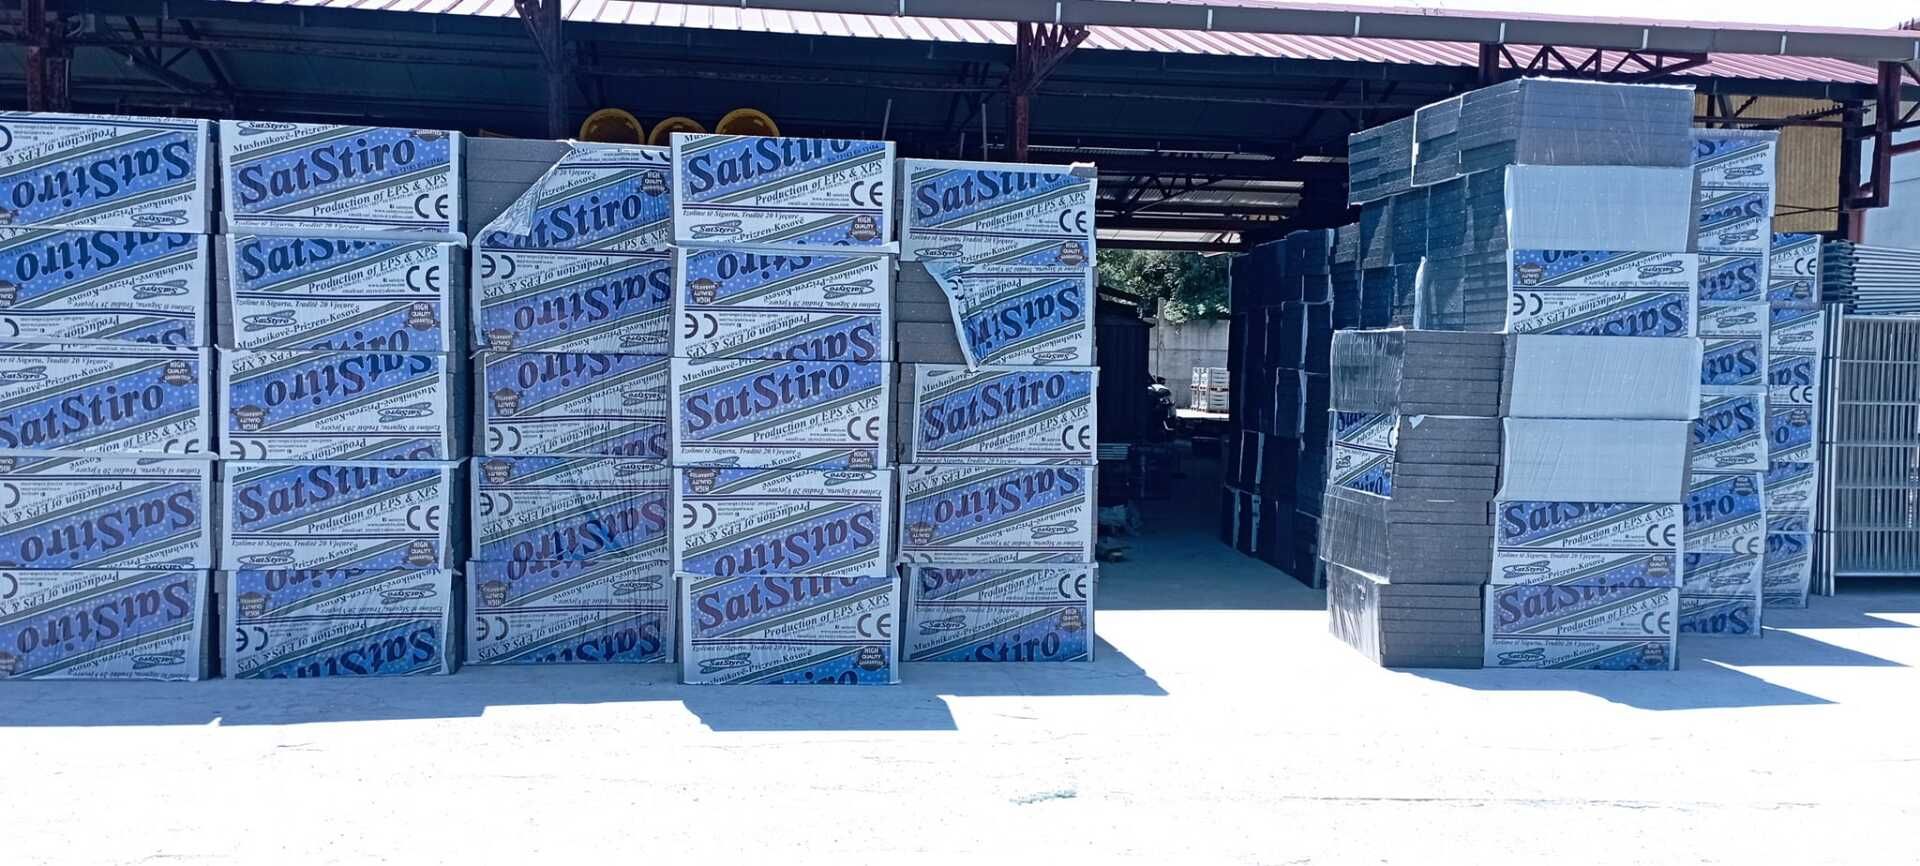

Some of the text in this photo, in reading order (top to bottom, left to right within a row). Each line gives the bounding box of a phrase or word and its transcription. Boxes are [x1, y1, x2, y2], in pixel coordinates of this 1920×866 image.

[44, 144, 54, 153] of
[58, 127, 117, 149] Production
[19, 150, 40, 159] EPS
[13, 140, 190, 208] SatStiro
[239, 139, 415, 206] SatStiro
[755, 184, 808, 205] Production
[812, 179, 821, 190] of
[825, 174, 846, 186] EPS
[861, 161, 882, 174] XPS
[313, 194, 369, 216] Production
[373, 189, 384, 200] of
[387, 183, 409, 198] EPS
[425, 174, 447, 188] XPS
[975, 212, 1024, 230] Production
[1026, 206, 1036, 218] of
[1037, 201, 1056, 213] EPS
[1069, 192, 1086, 205] XPS
[308, 272, 364, 293] Production
[367, 265, 377, 277] of
[380, 260, 402, 274] EPS
[416, 246, 438, 260] XPS
[543, 272, 554, 282] of
[558, 257, 609, 278] Production
[520, 275, 542, 288] EPS
[484, 287, 504, 298] XPS
[514, 268, 671, 330] SatStiro
[1579, 292, 1626, 313] Production
[1546, 311, 1566, 322] EPS
[1566, 306, 1577, 315] of
[745, 328, 756, 340] of
[760, 314, 810, 335] Production
[1514, 321, 1534, 332] XPS
[724, 335, 745, 347] EPS
[687, 347, 707, 359] XPS
[687, 364, 849, 433] SatStiro
[925, 374, 1065, 442] SatStiro
[0, 385, 164, 448] SatStiro
[753, 420, 807, 441] Production
[809, 415, 819, 426] of
[822, 409, 843, 422] EPS
[858, 397, 878, 410] XPS
[979, 431, 1026, 451] Production
[1029, 425, 1037, 437] of
[1040, 420, 1057, 432] EPS
[1071, 406, 1088, 419] XPS
[66, 481, 122, 499] Production
[935, 468, 1080, 523] SatStiro
[27, 504, 50, 517] EPS
[51, 500, 62, 508] of
[308, 512, 365, 533] Production
[367, 504, 378, 516] of
[380, 499, 402, 511] EPS
[416, 486, 438, 500] XPS
[757, 502, 810, 523] Production
[21, 490, 195, 561] SatStiro
[722, 524, 743, 537] EPS
[744, 516, 754, 527] of
[1562, 527, 1610, 547] Production
[1613, 523, 1621, 534] of
[1623, 518, 1642, 529] EPS
[1655, 506, 1673, 519] XPS
[685, 536, 707, 548] XPS
[714, 510, 874, 576] SatStiro
[17, 580, 190, 653] SatStiro
[764, 617, 818, 639] Production
[820, 611, 832, 624] of
[833, 607, 855, 619] EPS
[868, 594, 889, 607] XPS
